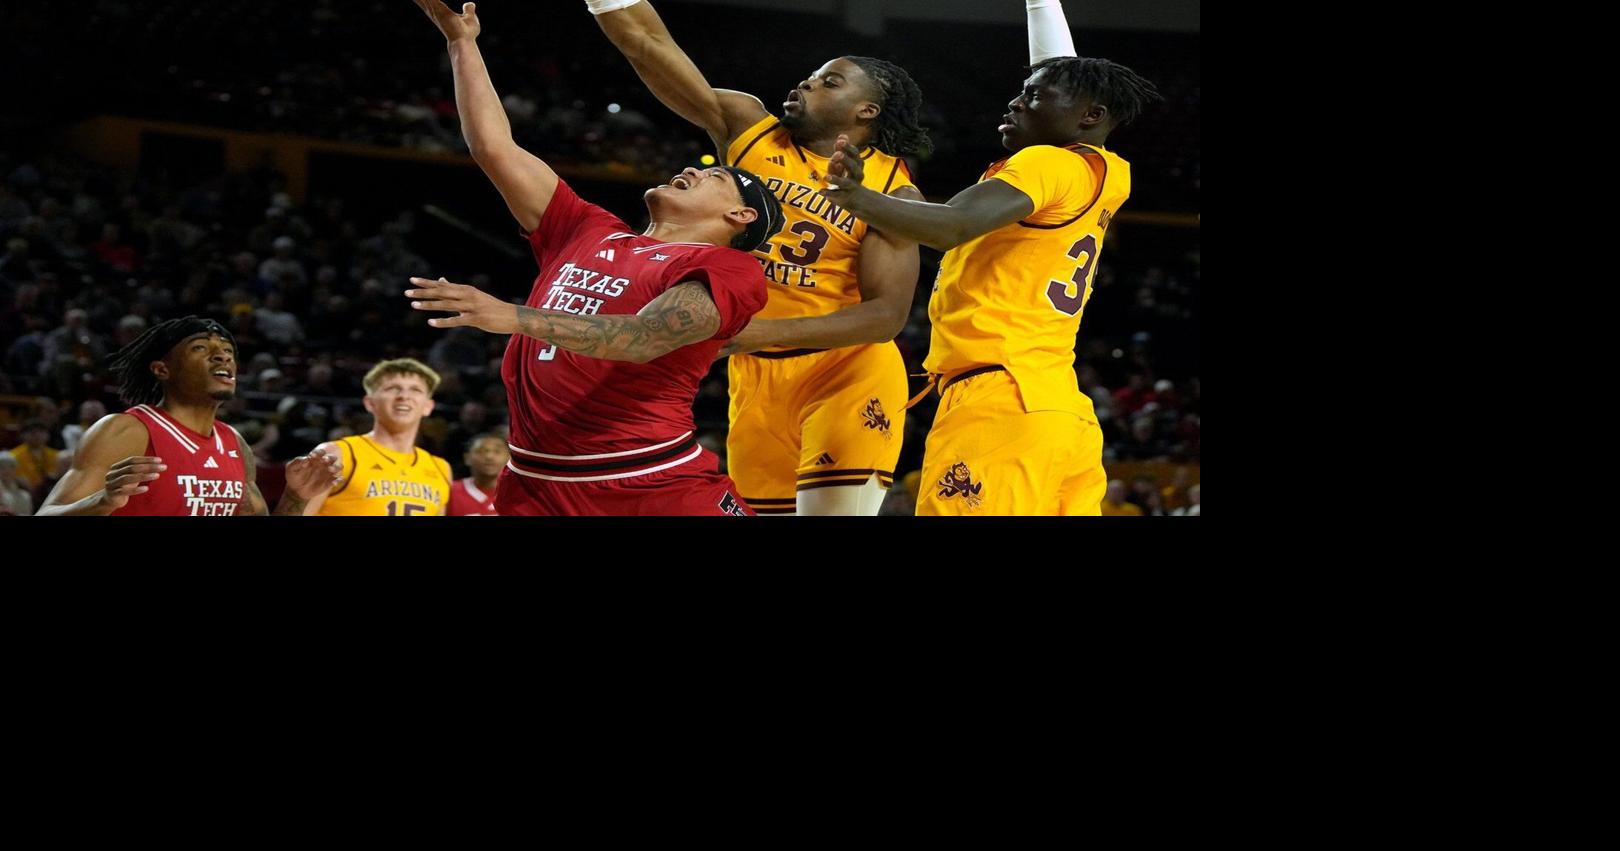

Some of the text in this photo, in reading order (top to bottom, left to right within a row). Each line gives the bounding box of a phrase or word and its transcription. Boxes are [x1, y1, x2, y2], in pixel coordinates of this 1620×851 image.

[757, 175, 857, 236] RIZONA
[552, 262, 630, 298] TEXAS
[757, 256, 818, 288] ATE
[541, 285, 605, 316] TECH
[177, 475, 243, 499] TEXAS
[366, 479, 441, 505] ARIZONA
